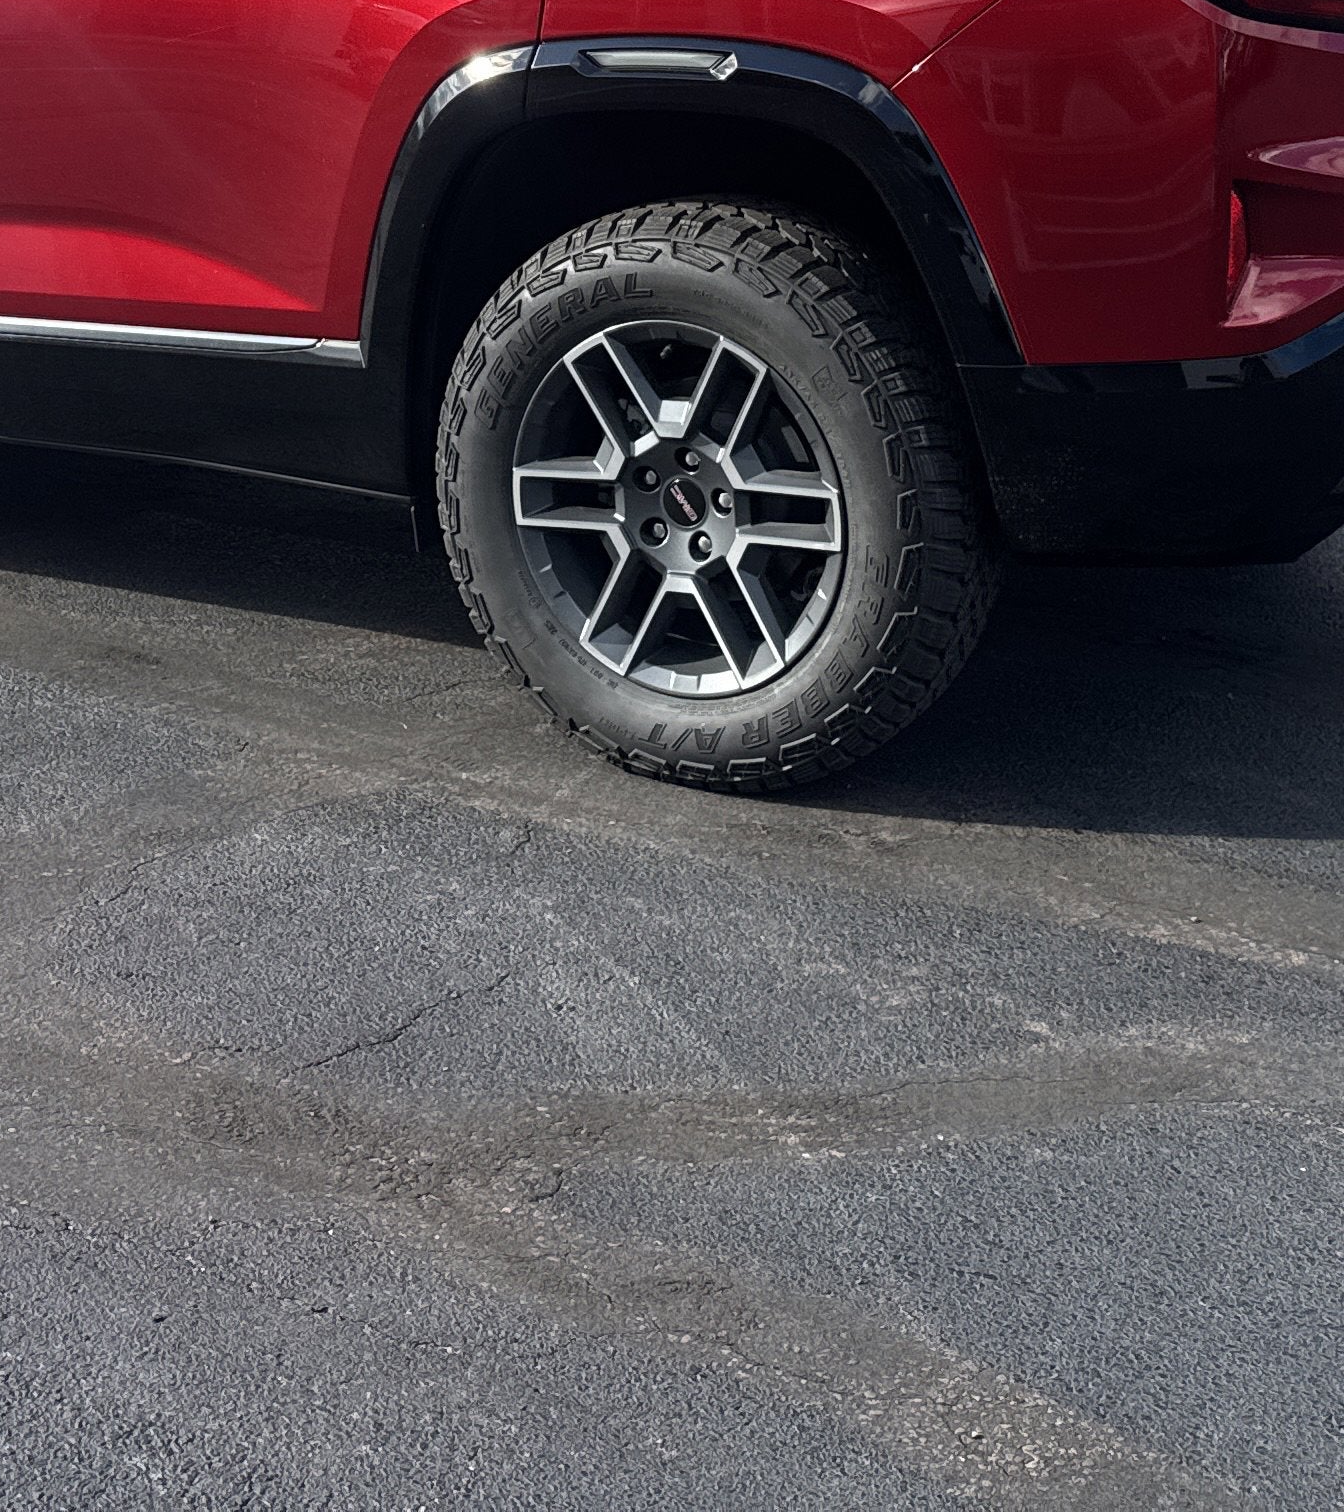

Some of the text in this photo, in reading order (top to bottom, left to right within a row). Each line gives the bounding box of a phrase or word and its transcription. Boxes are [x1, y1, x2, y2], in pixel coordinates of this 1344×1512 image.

[474, 272, 654, 430] GENERAL
[742, 544, 889, 749] GRABBER
[638, 722, 726, 754] A/T
